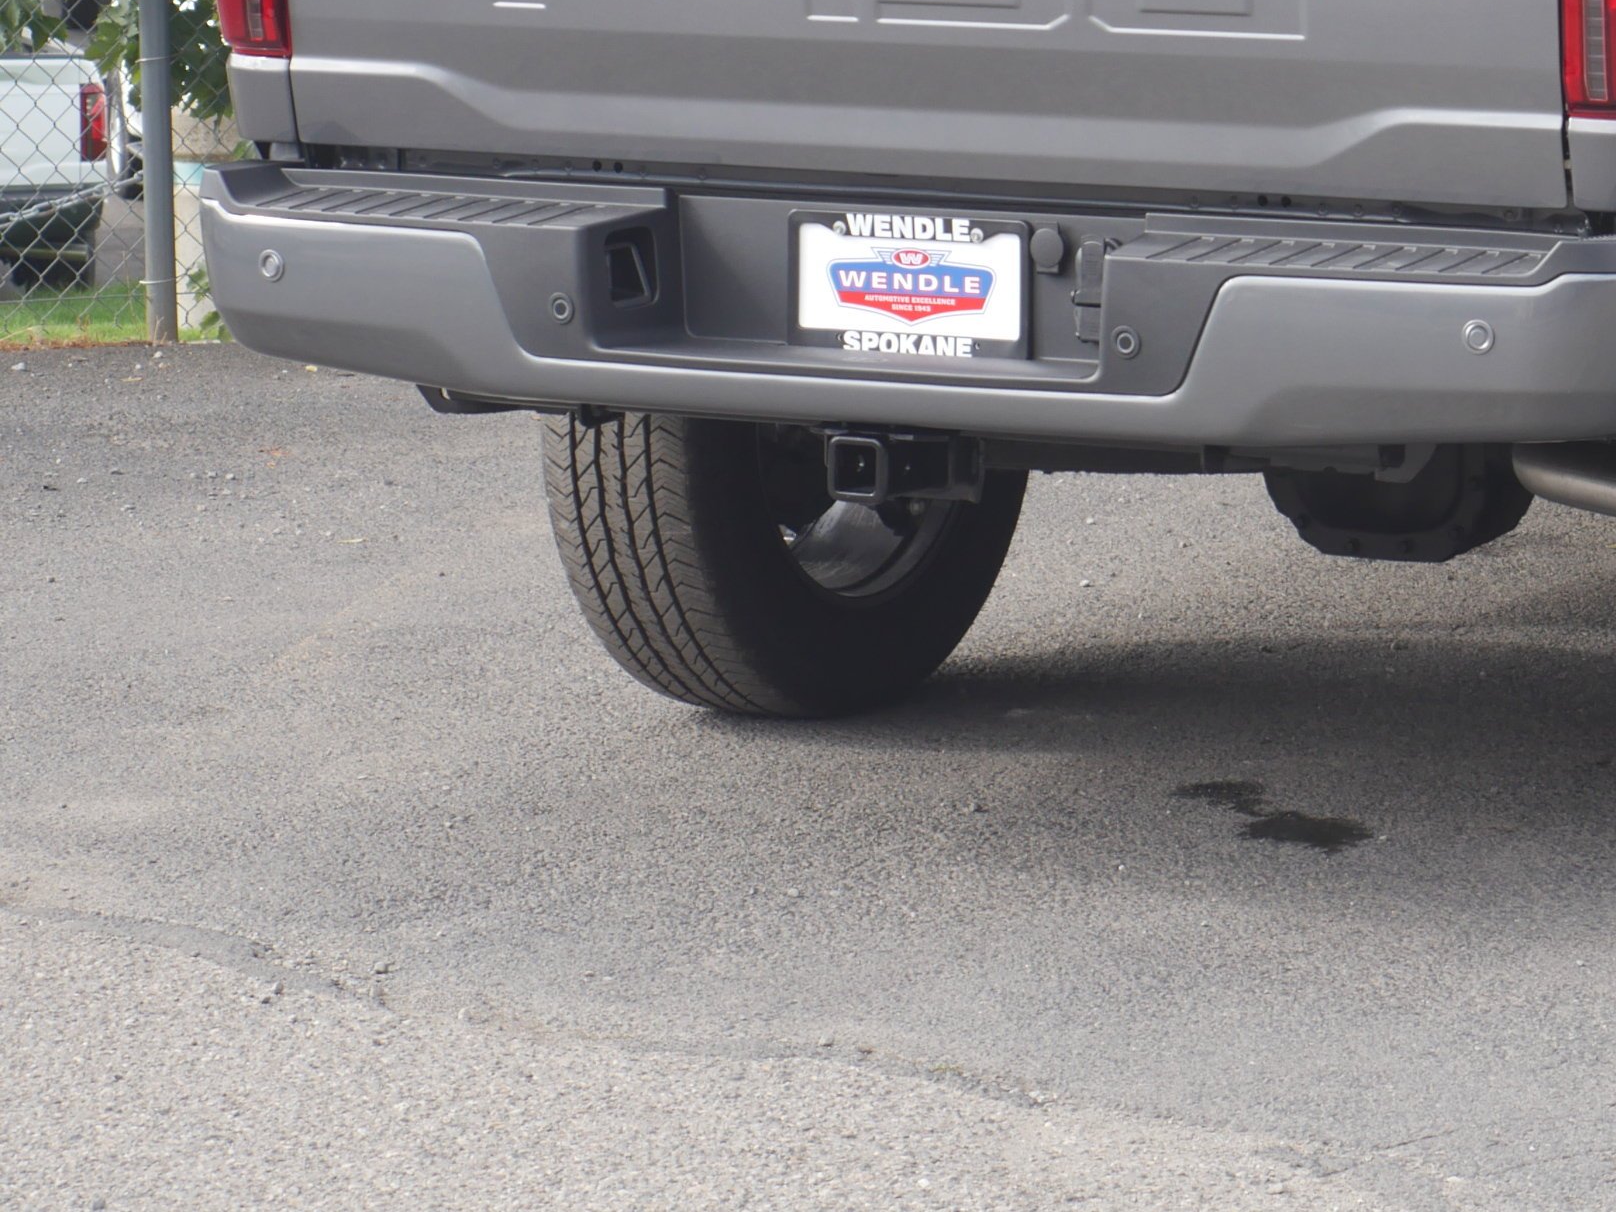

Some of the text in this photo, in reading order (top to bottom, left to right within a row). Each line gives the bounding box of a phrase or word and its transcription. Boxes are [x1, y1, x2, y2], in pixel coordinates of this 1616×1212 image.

[845, 213, 972, 243] WENDLE
[899, 252, 925, 266] W
[838, 270, 981, 295] WENDLE
[864, 294, 957, 306] AUTOMOTIVE EXCELLENCE
[843, 330, 973, 358] SPOKANE
